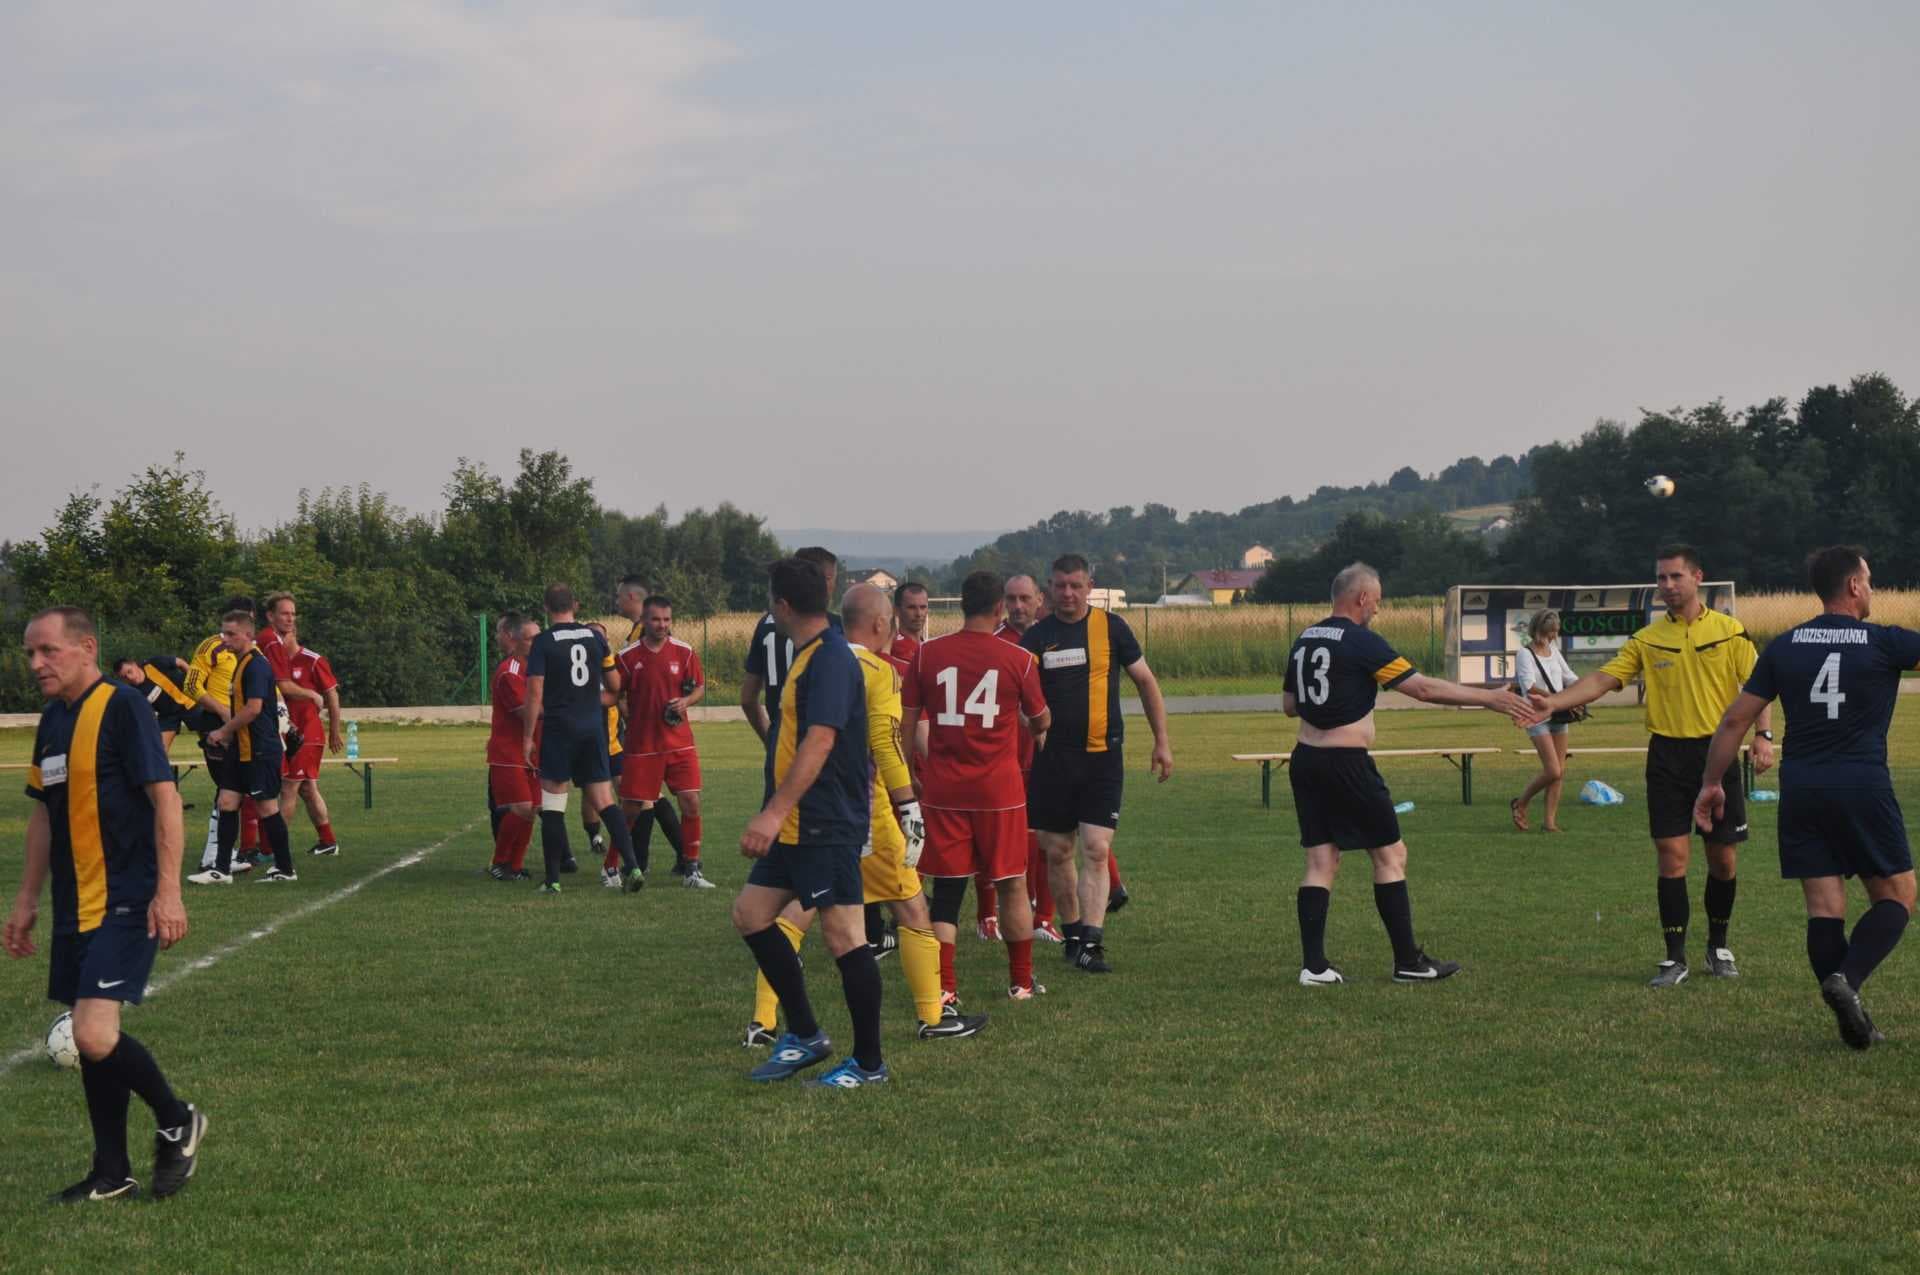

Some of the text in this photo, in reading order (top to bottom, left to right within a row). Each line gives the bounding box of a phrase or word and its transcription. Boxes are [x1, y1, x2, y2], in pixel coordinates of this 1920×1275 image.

[570, 643, 589, 687] 8
[1293, 646, 1331, 705] 13
[1810, 652, 1846, 719] 4
[936, 666, 1000, 728] 14
